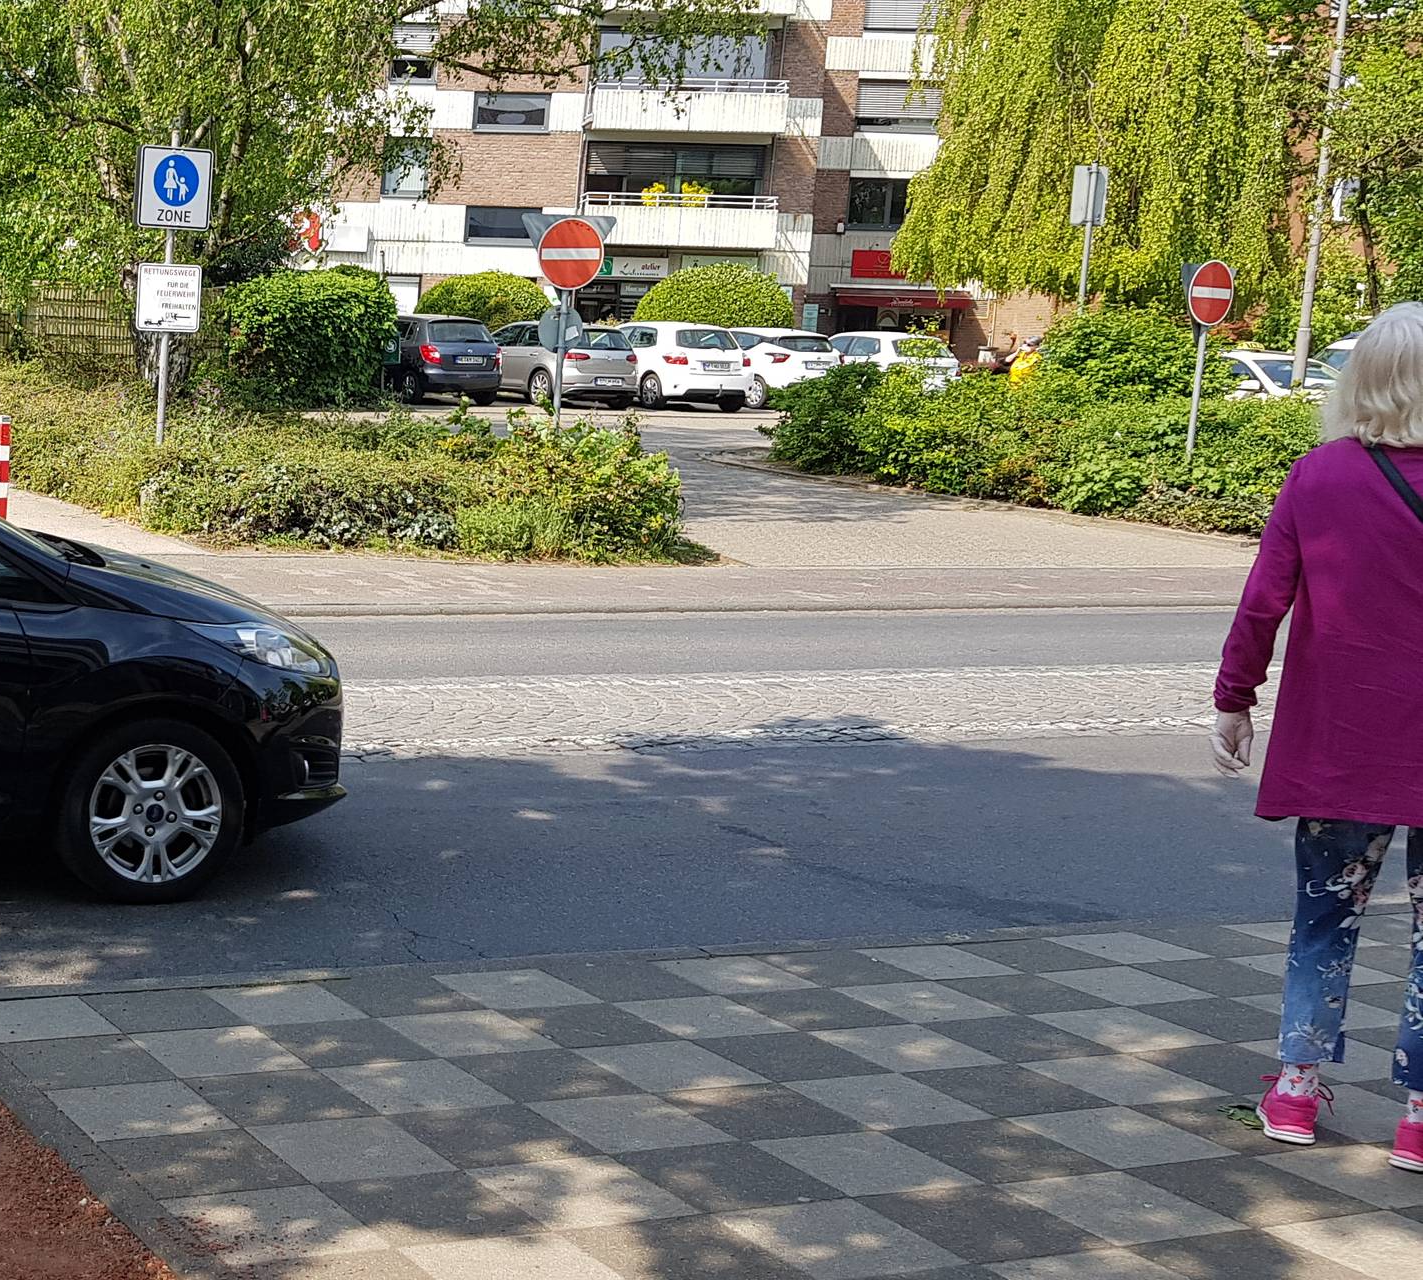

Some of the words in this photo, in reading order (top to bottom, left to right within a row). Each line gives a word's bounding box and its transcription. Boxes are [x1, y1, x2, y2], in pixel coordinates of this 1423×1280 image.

[156, 209, 192, 223] ZONE
[143, 267, 196, 277] RETTUNGSWEGE
[156, 290, 196, 298] FEUERWEHR
